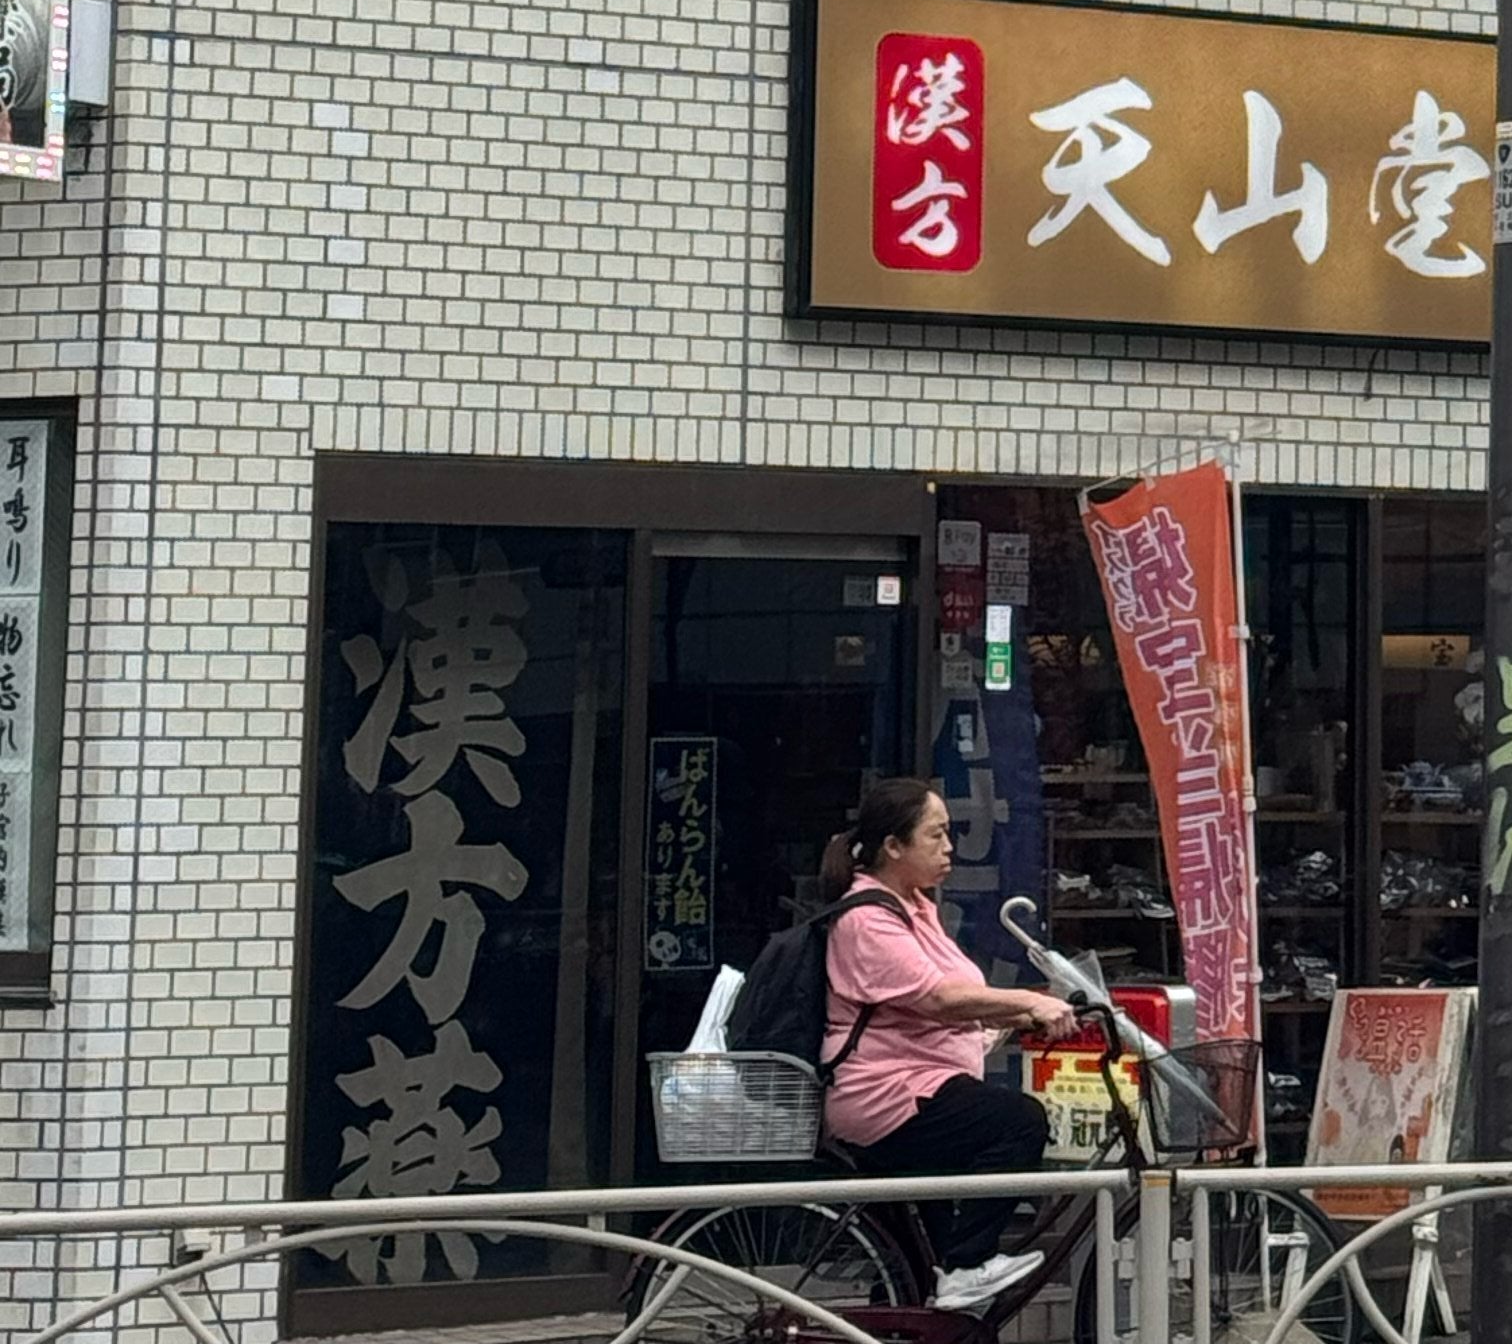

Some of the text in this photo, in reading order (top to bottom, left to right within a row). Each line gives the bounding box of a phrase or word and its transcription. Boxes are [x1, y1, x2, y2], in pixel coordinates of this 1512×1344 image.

[885, 52, 971, 258] 漢方
[654, 820, 676, 922] あります
